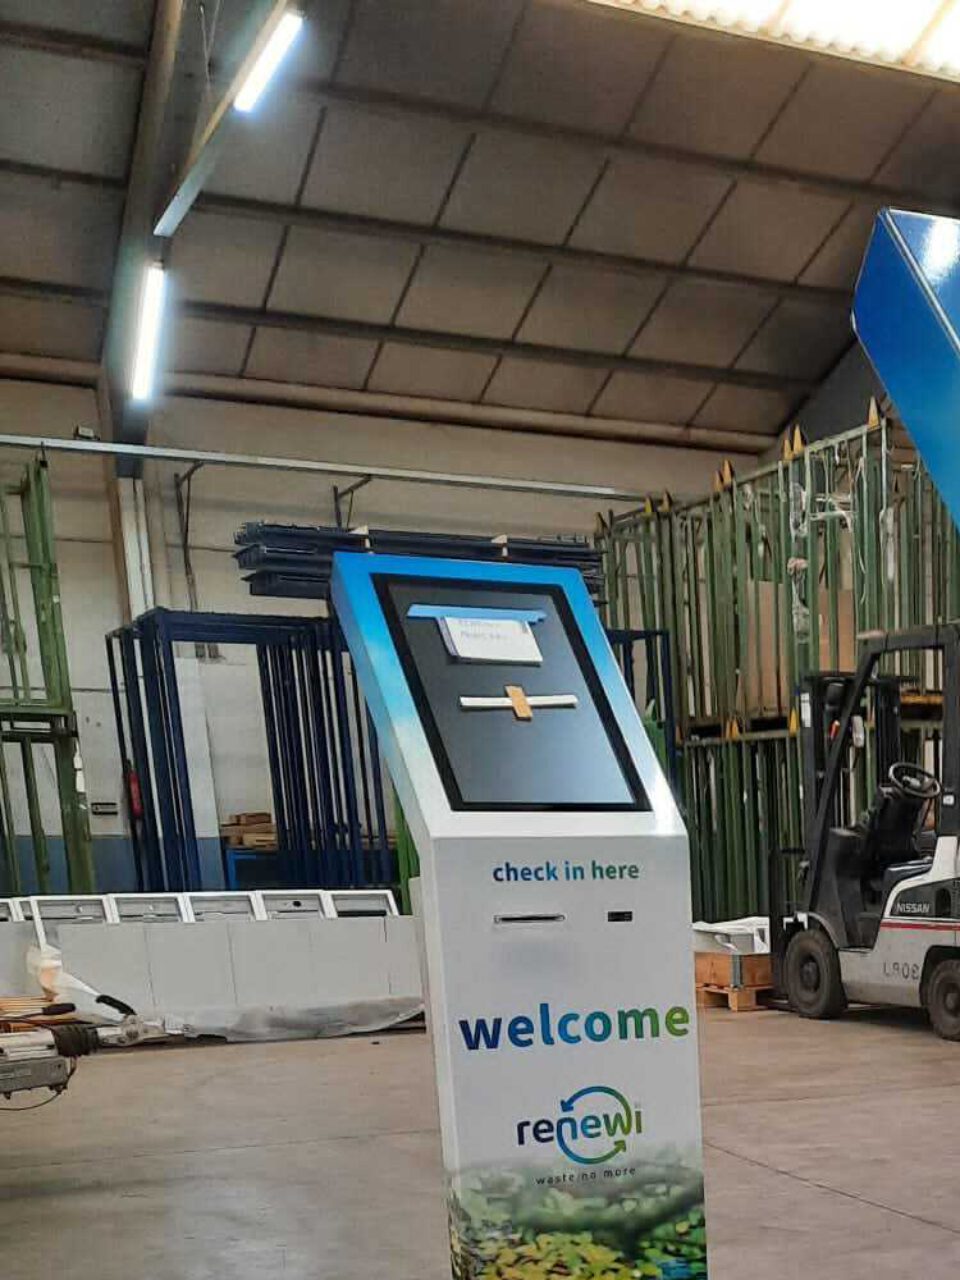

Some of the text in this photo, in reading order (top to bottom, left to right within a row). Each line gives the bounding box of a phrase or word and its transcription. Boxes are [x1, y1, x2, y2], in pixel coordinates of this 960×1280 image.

[493, 860, 640, 882] check in here
[896, 902, 930, 913] NISSAN
[458, 1002, 690, 1050] welcome
[517, 1105, 642, 1148] renewi
[535, 1167, 636, 1185] waste no more
